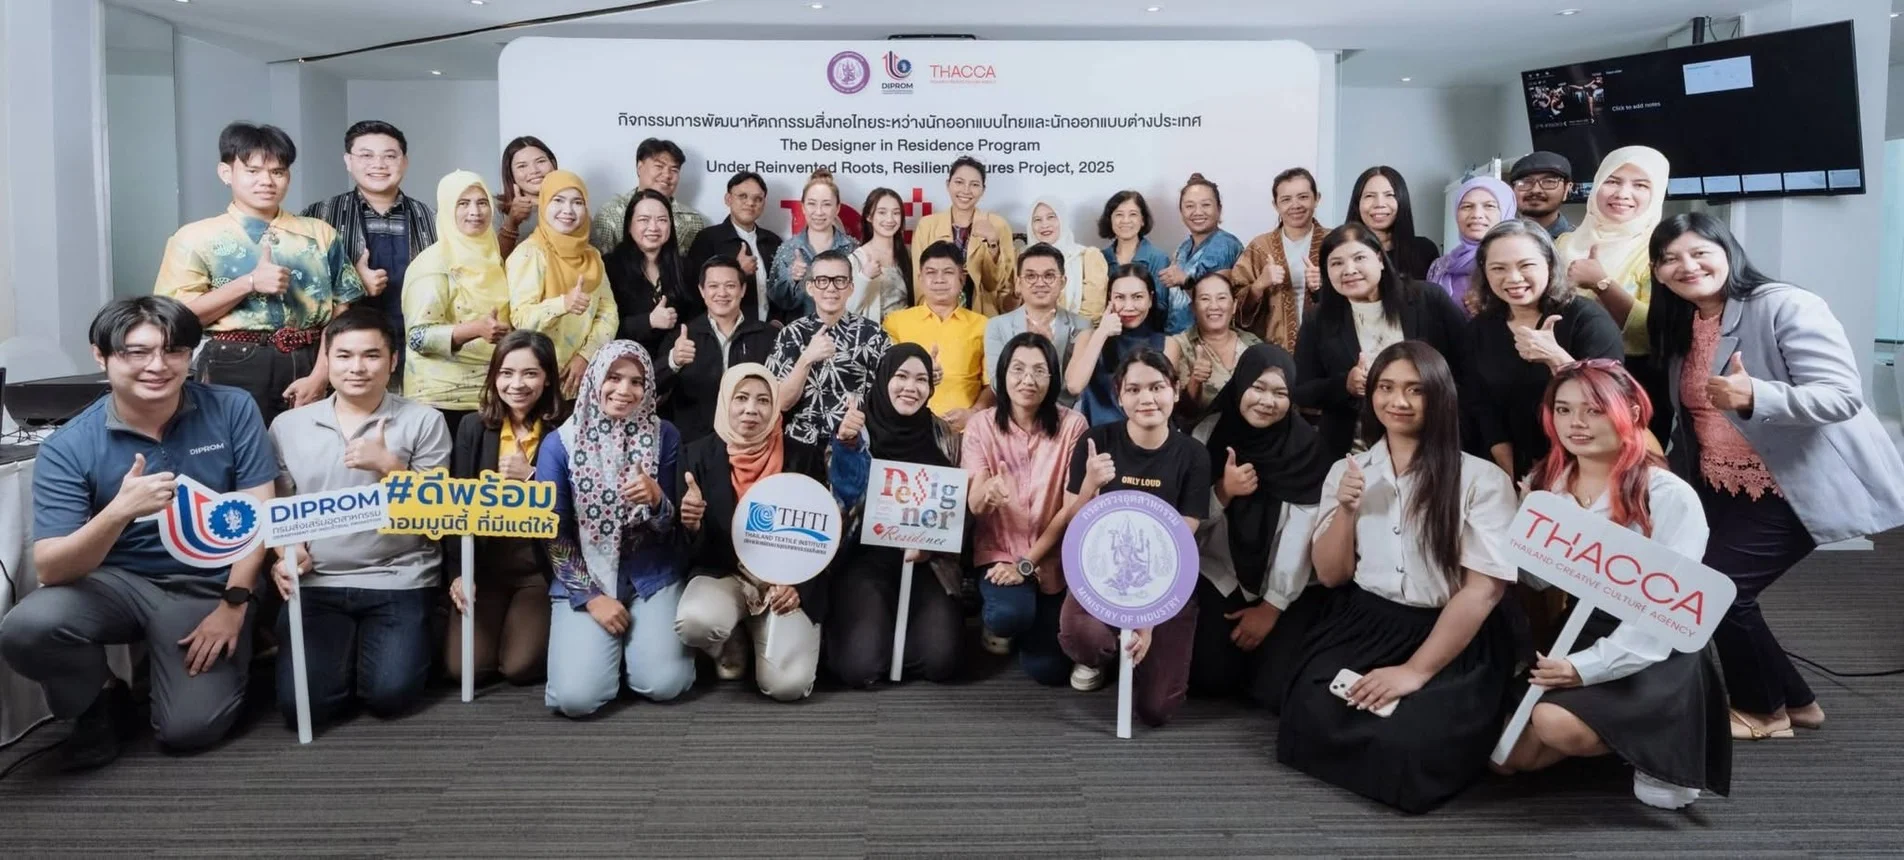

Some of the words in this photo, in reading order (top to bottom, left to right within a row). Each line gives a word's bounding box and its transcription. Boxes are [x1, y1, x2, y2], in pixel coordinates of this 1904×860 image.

[930, 65, 996, 78] THACCA
[617, 111, 1202, 130] กิจกรรมการพัฒนาหัตถกรรมสิ่งทอไทยระหว่างนักออกแบบไทยและนักออกแบบต่างประเทศ
[780, 138, 807, 151] The
[811, 138, 876, 154] Designer
[880, 138, 893, 151] in
[898, 139, 973, 152] Residence
[978, 139, 1040, 155] Program
[706, 160, 751, 173] Under
[755, 161, 836, 174] Reinvented
[841, 162, 888, 176] Roots,
[893, 161, 950, 174] Resilien
[1019, 161, 1074, 177] Project,
[1078, 161, 1115, 174] 2025
[189, 443, 224, 455] DIPROM
[386, 472, 551, 508] #ดีพร้อม
[1121, 476, 1140, 486] ONLY
[1141, 479, 1161, 487] LOUD
[271, 490, 379, 523] DIPROM
[1082, 494, 1180, 526] กระทรวงอุตสาหกรรม
[478, 510, 553, 533] ที่มีแต่ให้
[779, 507, 829, 531] THTI
[744, 531, 773, 541] THAILAND
[774, 535, 797, 545] TEXTILE
[798, 540, 828, 549] INSTITUTE
[881, 526, 946, 545] Residence
[1525, 508, 1704, 625] THACCA
[1509, 538, 1556, 566] THAILAND
[1555, 562, 1601, 590] CREATIVE
[1602, 586, 1647, 613] CULTURE
[1649, 610, 1696, 637] AGENCY
[1077, 586, 1118, 620] MINISTRY
[1120, 614, 1134, 623] OF
[1136, 595, 1180, 624] INDUSTRY
